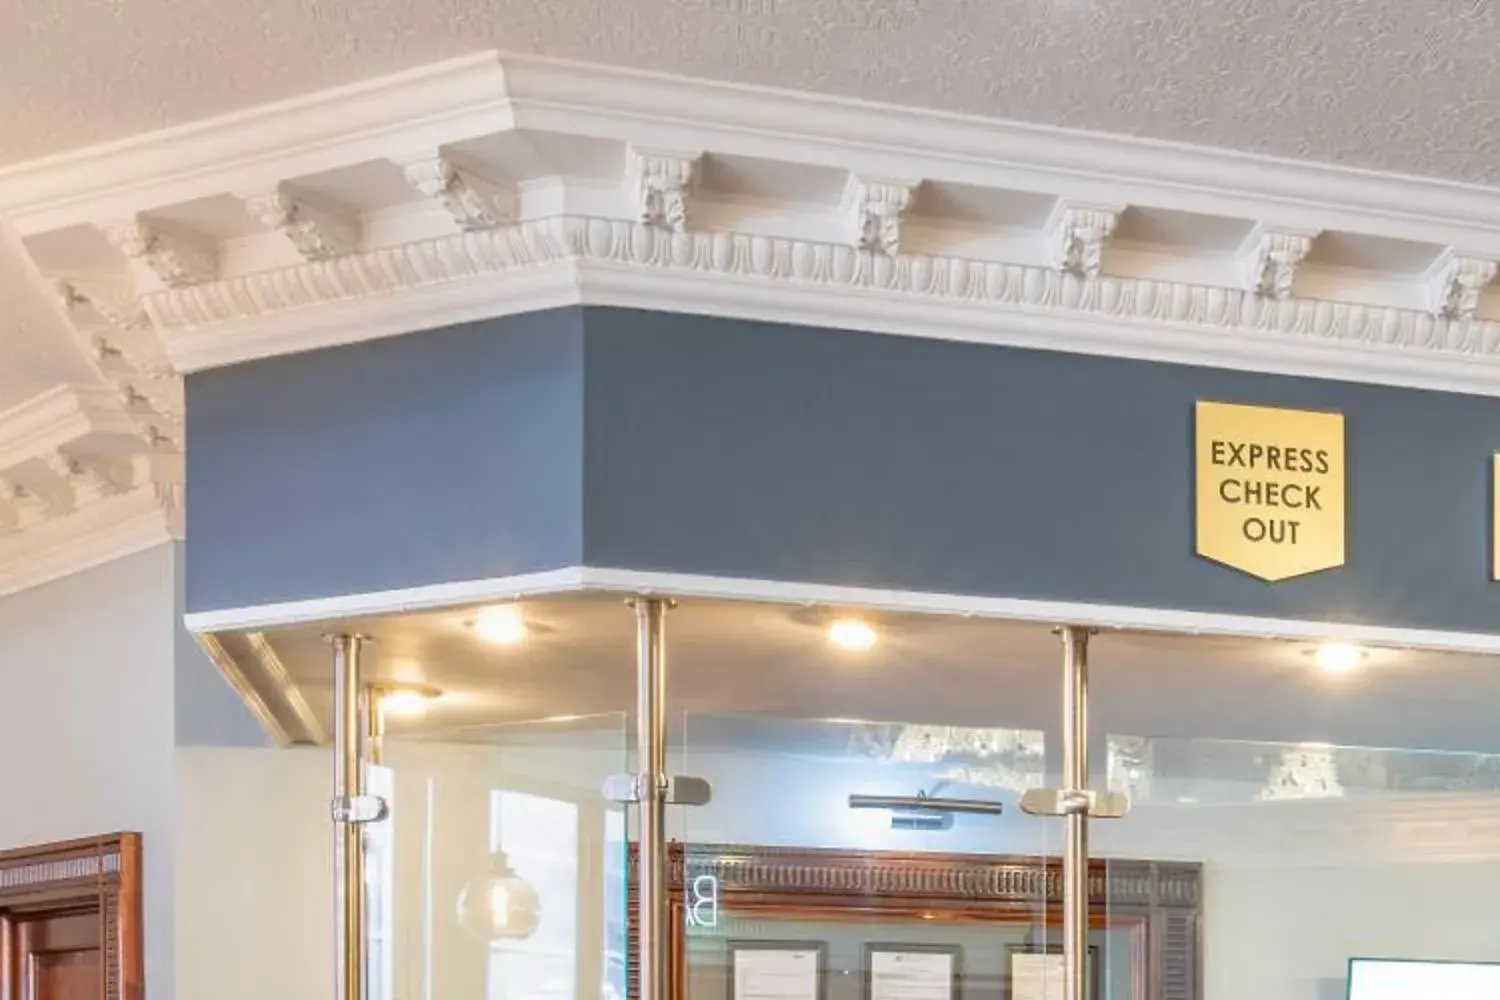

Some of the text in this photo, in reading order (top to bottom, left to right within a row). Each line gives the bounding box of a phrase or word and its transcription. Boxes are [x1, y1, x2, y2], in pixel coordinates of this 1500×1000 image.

[1211, 441, 1329, 474] EXPRESS
[1219, 479, 1322, 511] CHECK
[1243, 517, 1300, 544] OUT
